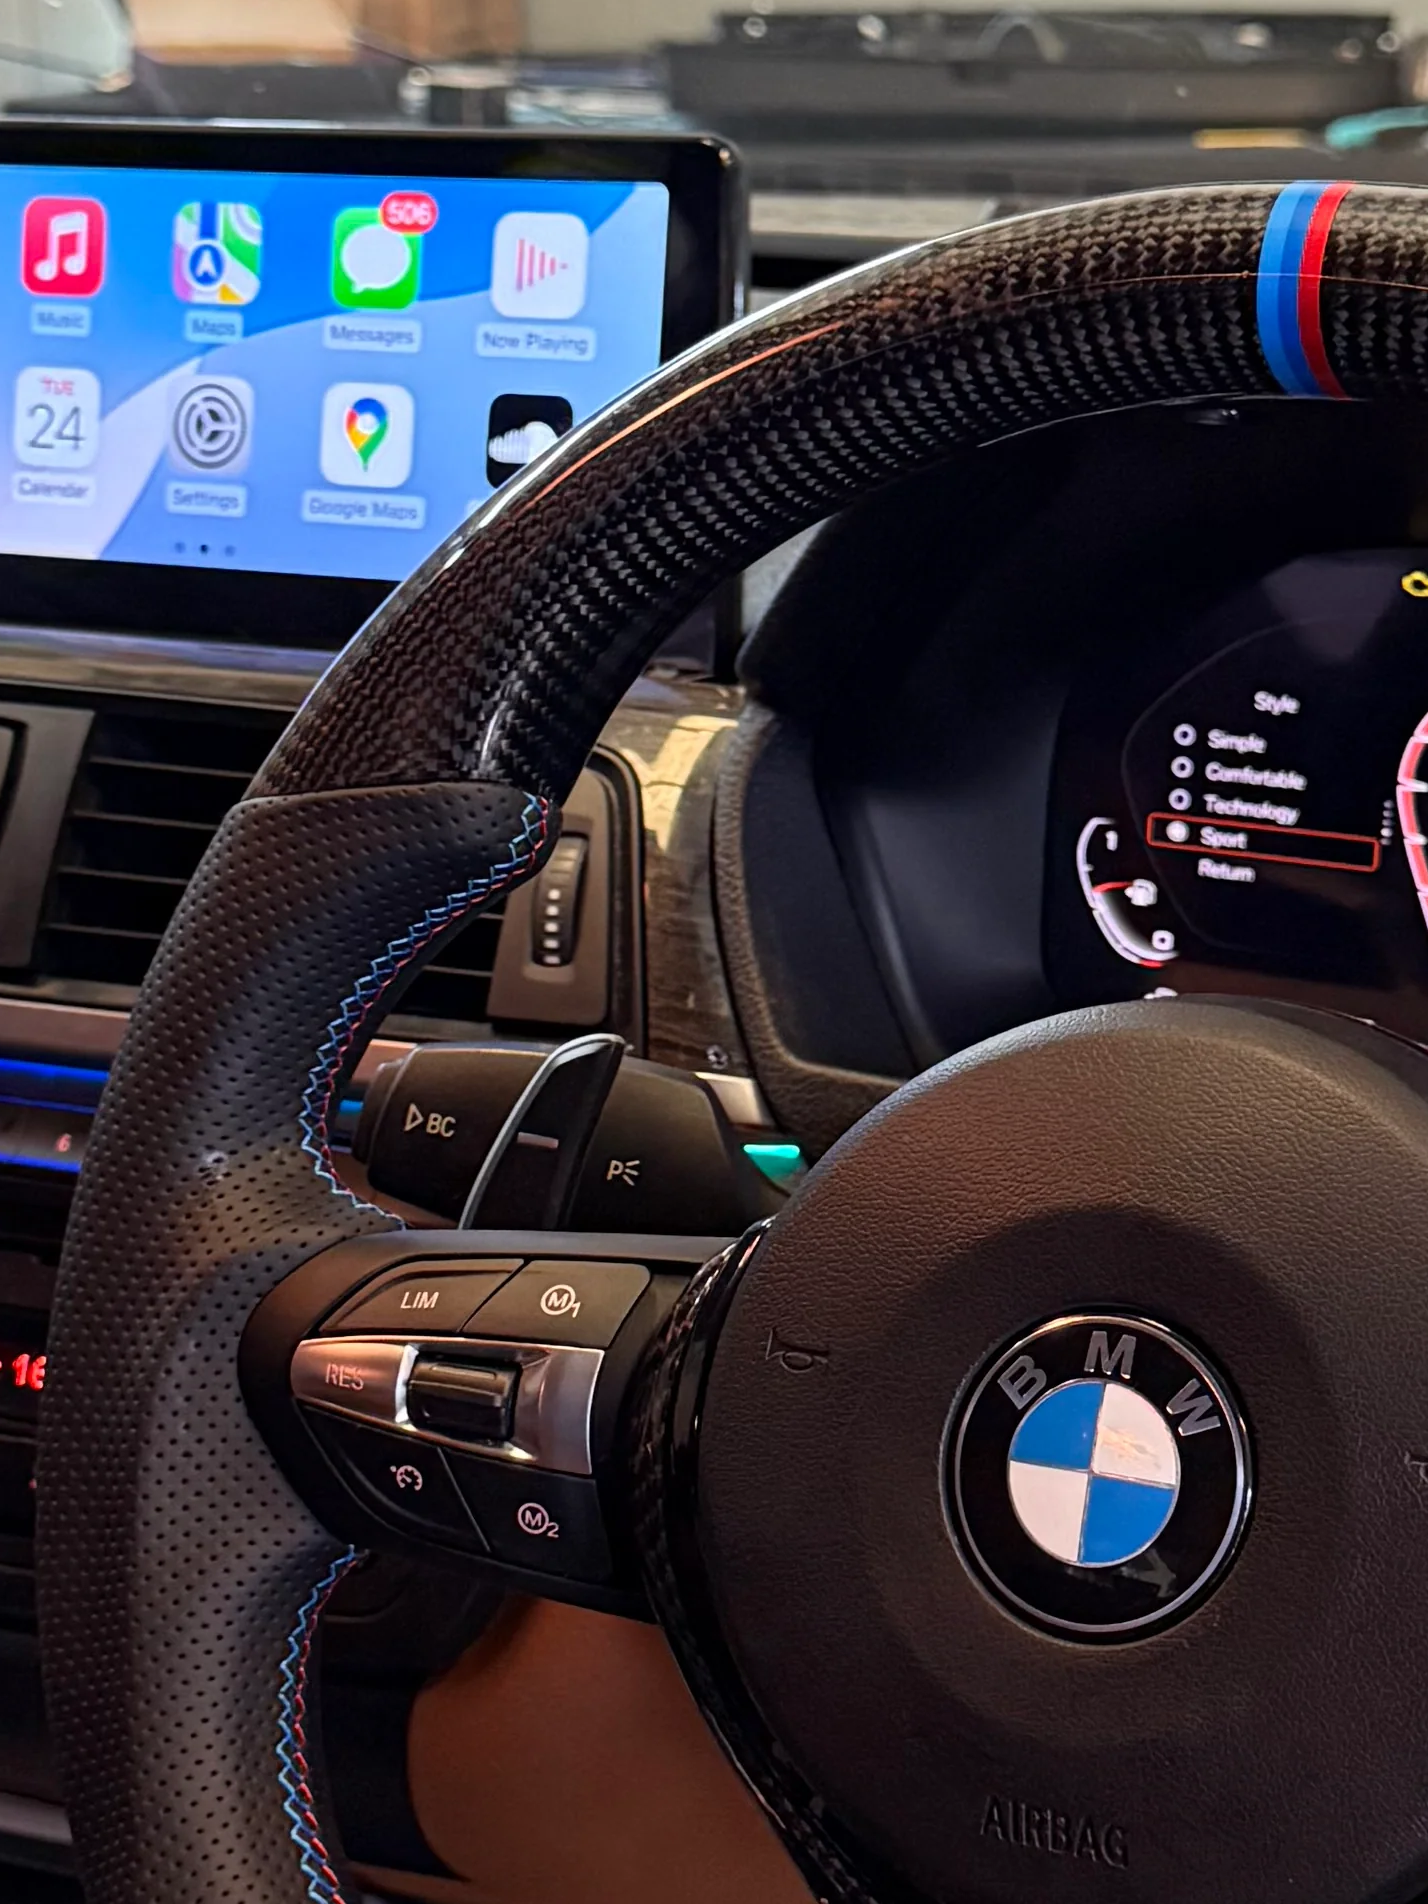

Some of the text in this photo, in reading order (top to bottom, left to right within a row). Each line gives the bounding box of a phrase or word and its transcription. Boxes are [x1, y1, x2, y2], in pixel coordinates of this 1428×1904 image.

[385, 201, 432, 225] 506
[36, 310, 86, 331] Music
[191, 318, 237, 338] Maps
[329, 324, 414, 347] Messages
[482, 331, 589, 356] Now Playing
[26, 402, 87, 451] 24
[18, 479, 90, 499] Calendar
[172, 487, 240, 511] Settings
[308, 498, 418, 522] Google Maps
[1254, 690, 1301, 716] Style
[1207, 728, 1268, 754] Simple
[1204, 761, 1308, 791] Comfortable
[1202, 793, 1301, 826] Technology
[1200, 825, 1249, 850] Sport
[1197, 857, 1257, 883] Return
[426, 1112, 457, 1138] BC
[54, 1132, 73, 1153] 6
[399, 1290, 440, 1311] LIM
[324, 1361, 365, 1391] RES
[997, 1330, 1221, 1438] BMW
[981, 1794, 1130, 1869] AIRBAG
